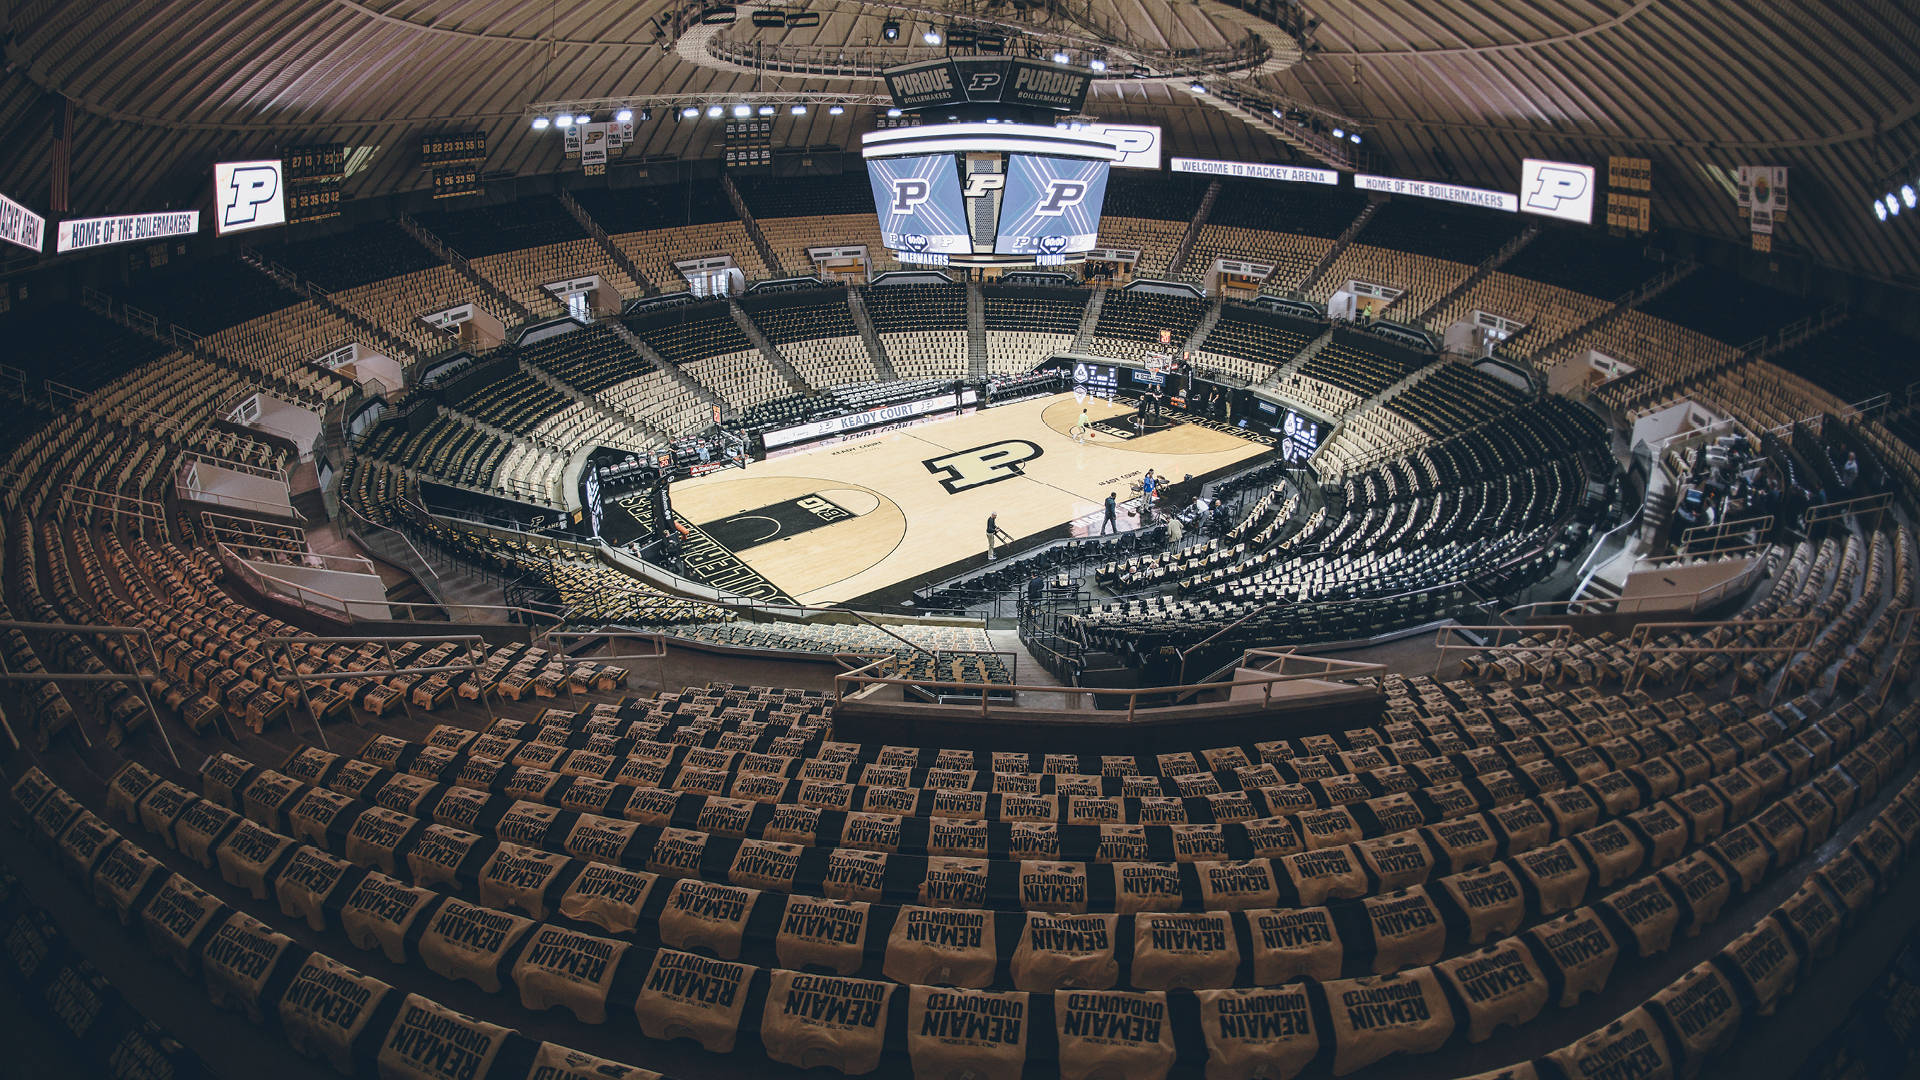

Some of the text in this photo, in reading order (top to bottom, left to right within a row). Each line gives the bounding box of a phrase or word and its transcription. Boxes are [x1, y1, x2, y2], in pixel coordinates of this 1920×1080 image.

[892, 68, 952, 96] PURDUE
[968, 73, 1000, 90] P
[1015, 68, 1084, 96] PURDUE
[904, 92, 952, 104] BOILERMAKERS
[1018, 91, 1071, 104] BOILERMAKERS
[584, 132, 604, 144] P
[584, 164, 605, 176] 1932
[1182, 161, 1324, 182] WELCOME TO MACKEY ARENA
[224, 166, 278, 227] P
[892, 178, 930, 214] P
[964, 173, 1005, 197] P
[1035, 179, 1087, 216] P
[1366, 178, 1504, 207] HOME OF THE BOILERMAKERS
[1527, 166, 1587, 211] P
[0, 199, 40, 249] ACKEY ARENA
[72, 214, 191, 248] HOME OF THE BOILERMAKERS
[1036, 255, 1065, 265] PURDUE
[841, 411, 876, 428] KEADY
[881, 404, 913, 419] COURT
[922, 439, 1044, 495] P
[1006, 806, 1056, 818] REMAIN
[567, 838, 622, 860] REMAIN
[578, 828, 628, 848] UNDAUNTED
[932, 835, 987, 850] REMAIN
[499, 851, 553, 877] UNDAUNTED
[736, 860, 795, 881] REMAIN
[742, 850, 801, 868] UNDAUNTED
[364, 871, 420, 899] UNDAUNTED
[488, 862, 544, 890] REMAIN
[586, 867, 647, 892] UNDAUNTED
[1023, 874, 1084, 888] UNDAUNTED
[349, 880, 410, 924] REMAIN
[576, 874, 639, 906] REMAIN
[681, 882, 748, 901] UNDAUNTED
[1024, 885, 1084, 903] REMAIN
[1466, 883, 1519, 908] REMAIN
[146, 898, 193, 938] REMAIN
[446, 903, 513, 929] UNDAUNTED
[675, 891, 746, 921] REMAIN
[790, 904, 863, 926] UNDAUNTED
[909, 911, 983, 927] UNDAUNTED
[1369, 896, 1425, 917] UNDAUNTED
[1624, 891, 1673, 926] REMAIN
[434, 914, 505, 952] REMAIN
[783, 915, 860, 944] REMAIN
[1031, 917, 1106, 931] UNDAUNTED
[1152, 916, 1224, 930] UNDAUNTED
[1258, 912, 1326, 929] UNDAUNTED
[1376, 906, 1436, 937] REMAIN
[220, 924, 278, 968] UNDAUNTED
[540, 931, 612, 957] UNDAUNTED
[907, 924, 981, 948] REMAIN
[1032, 929, 1108, 951] REMAIN
[1152, 929, 1225, 950] REMAIN
[1264, 924, 1330, 950] REMAIN
[1553, 928, 1611, 969] REMAIN
[206, 937, 267, 979] REMAIN
[526, 941, 608, 982] REMAIN
[659, 953, 743, 977] UNDAUNTED
[1455, 950, 1521, 981] UNDAUNTED
[1746, 943, 1788, 984] REMAIN
[299, 965, 370, 1006] UNDAUNTED
[648, 969, 742, 1007] REMAIN
[791, 976, 884, 1001] UNDAUNTED
[1343, 980, 1419, 1007] UNDAUNTED
[1462, 964, 1534, 1003] REMAIN
[283, 979, 361, 1030] REMAIN
[784, 991, 881, 1028] REMAIN
[927, 994, 1023, 1017] UNDAUNTED
[1068, 994, 1163, 1019] UNDAUNTED
[1218, 994, 1305, 1013] UNDAUNTED
[1349, 998, 1430, 1030] REMAIN
[1678, 986, 1732, 1038] REMAIN
[404, 1006, 490, 1049] UNDAUNTED
[921, 1011, 1019, 1044] REMAIN
[1064, 1011, 1161, 1042] REMAIN
[1221, 1012, 1309, 1039] REMAIN
[389, 1023, 482, 1080] REMAIN
